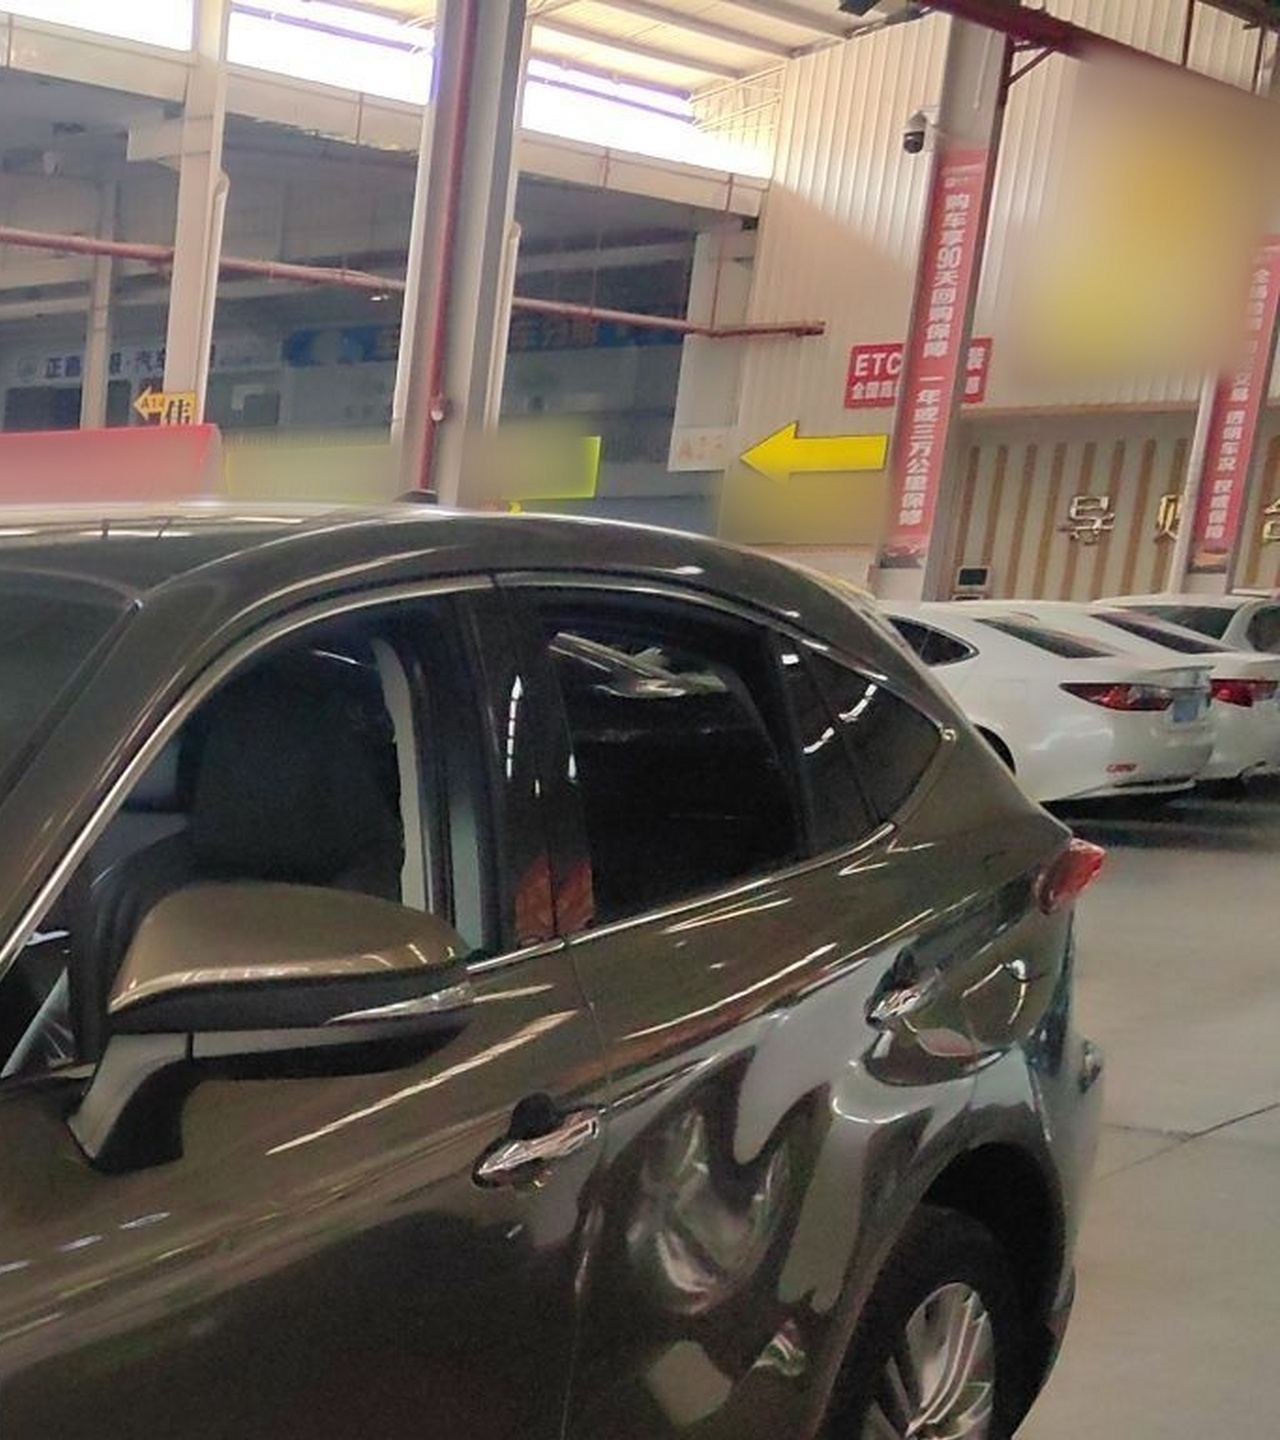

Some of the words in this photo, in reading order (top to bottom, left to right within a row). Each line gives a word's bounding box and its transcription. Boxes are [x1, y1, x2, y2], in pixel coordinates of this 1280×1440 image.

[923, 193, 971, 358] 购车享90天回购保障
[899, 375, 945, 525] 一年或三万公里保障
